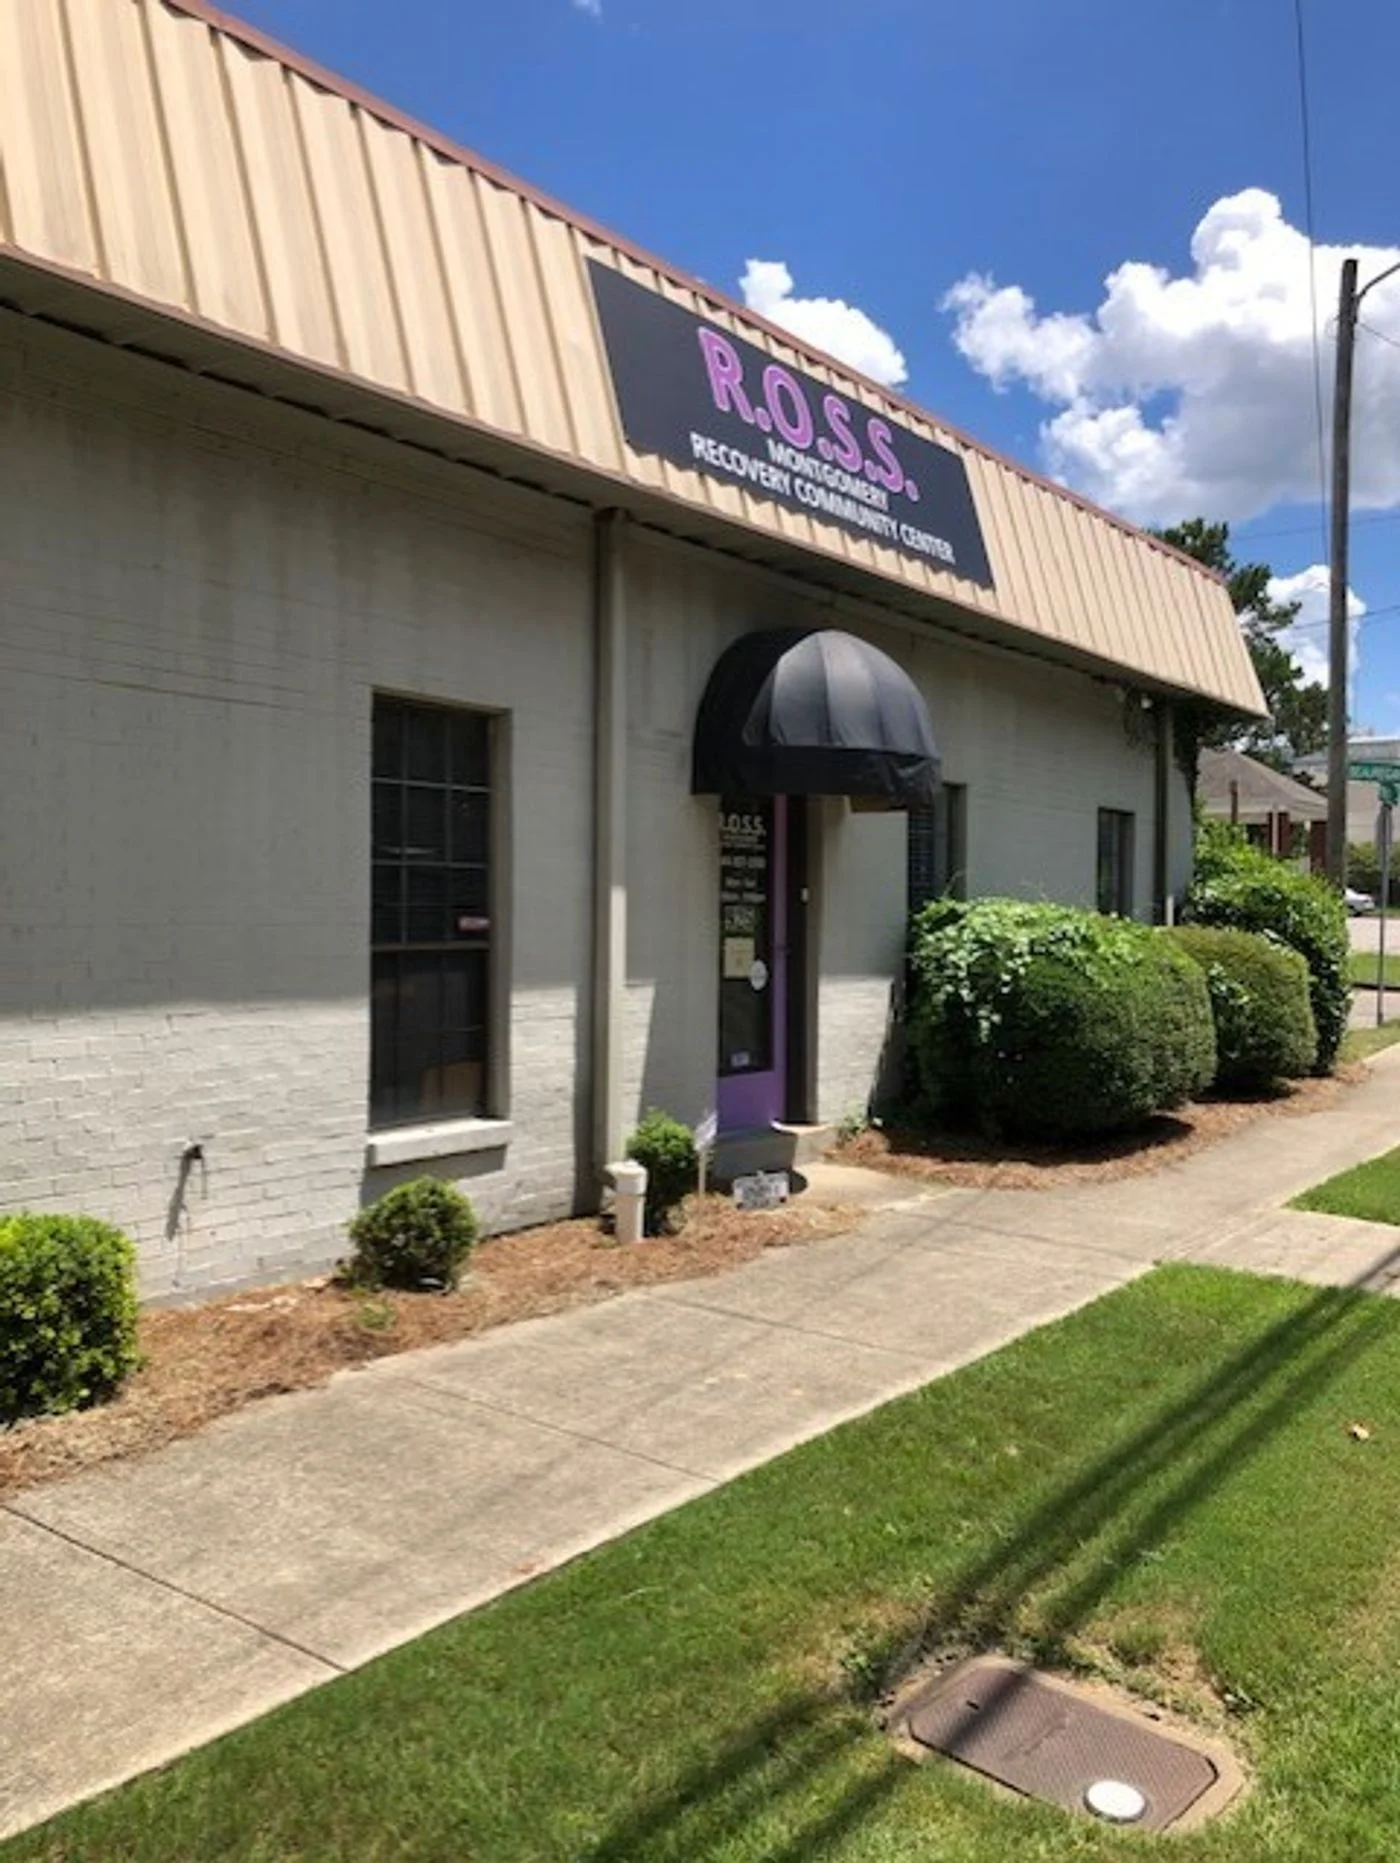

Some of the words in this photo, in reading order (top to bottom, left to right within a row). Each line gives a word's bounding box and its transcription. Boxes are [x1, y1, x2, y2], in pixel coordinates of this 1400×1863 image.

[698, 326, 919, 501] R.O.S.S.
[767, 437, 889, 512] MONTGOMERY
[690, 431, 791, 496] RECOVERY
[794, 477, 899, 540] COMMUNITY
[900, 523, 956, 565] CENTER
